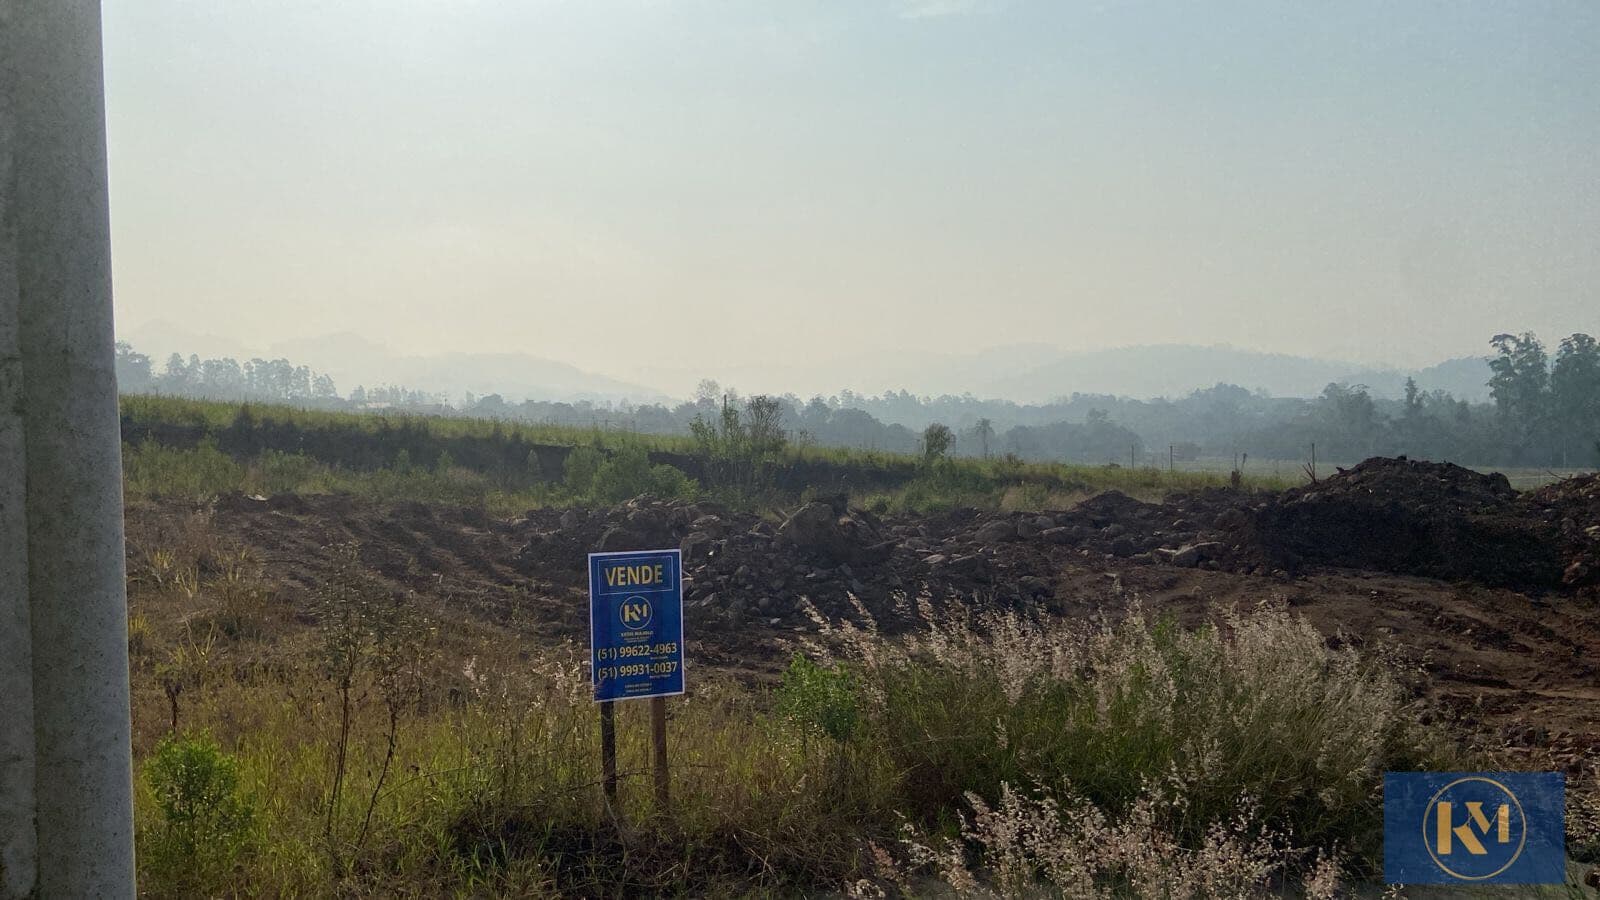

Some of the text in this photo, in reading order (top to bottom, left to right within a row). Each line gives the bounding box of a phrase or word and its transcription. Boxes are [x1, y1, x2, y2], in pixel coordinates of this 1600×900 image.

[605, 564, 663, 586] VENDE
[598, 643, 677, 661] (51) 99622-4963
[598, 661, 677, 680] (51) 99931-0037
